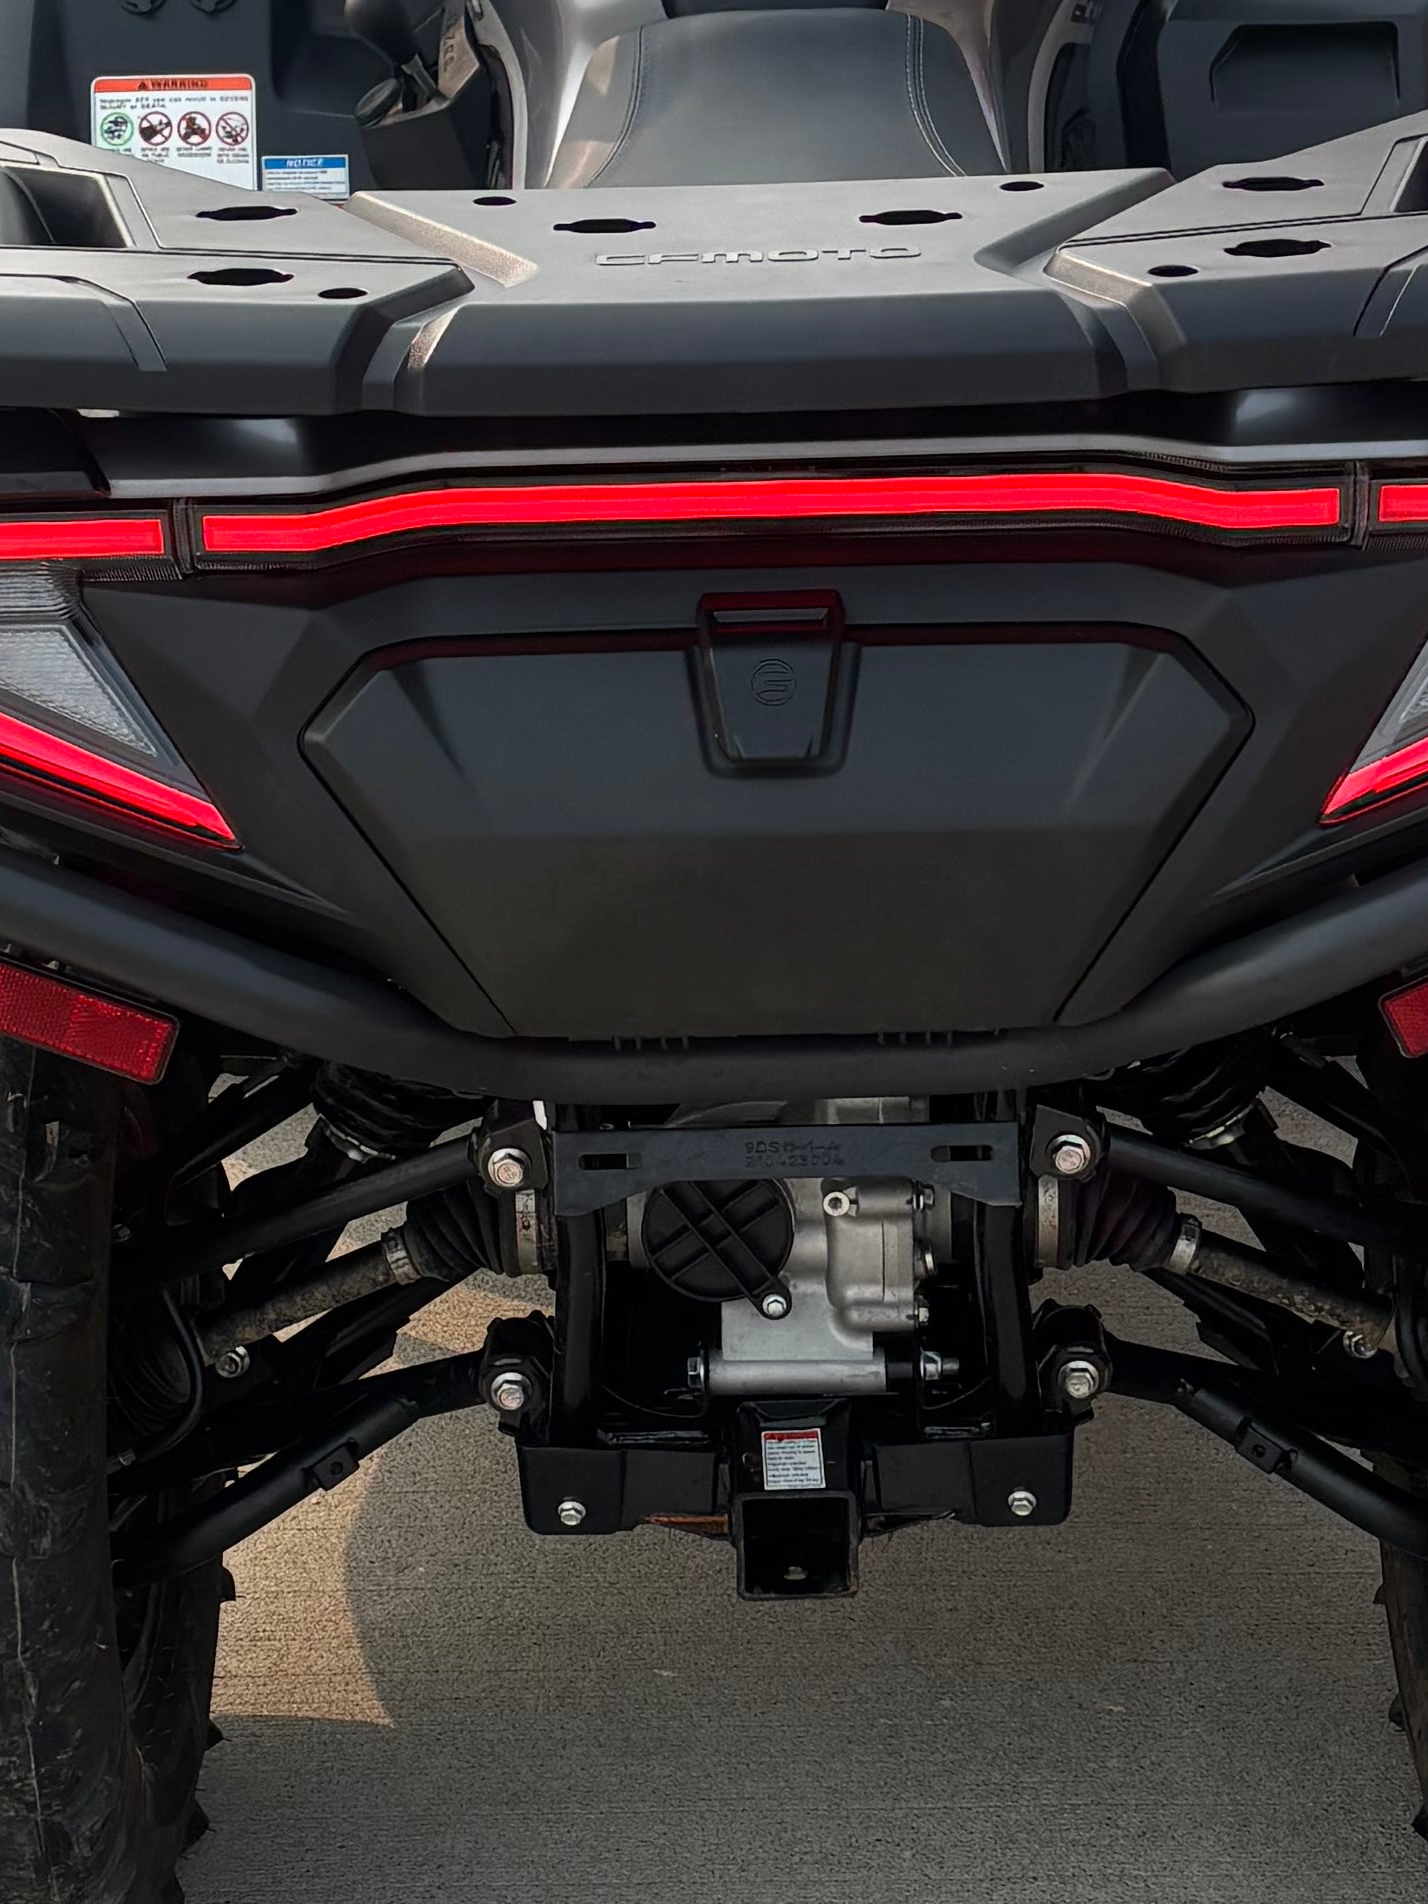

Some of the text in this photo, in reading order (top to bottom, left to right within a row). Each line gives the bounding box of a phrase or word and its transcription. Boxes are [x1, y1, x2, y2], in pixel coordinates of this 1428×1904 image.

[151, 78, 209, 90] WARNING
[286, 158, 324, 167] NOTICE
[595, 245, 922, 266] CFMOTO
